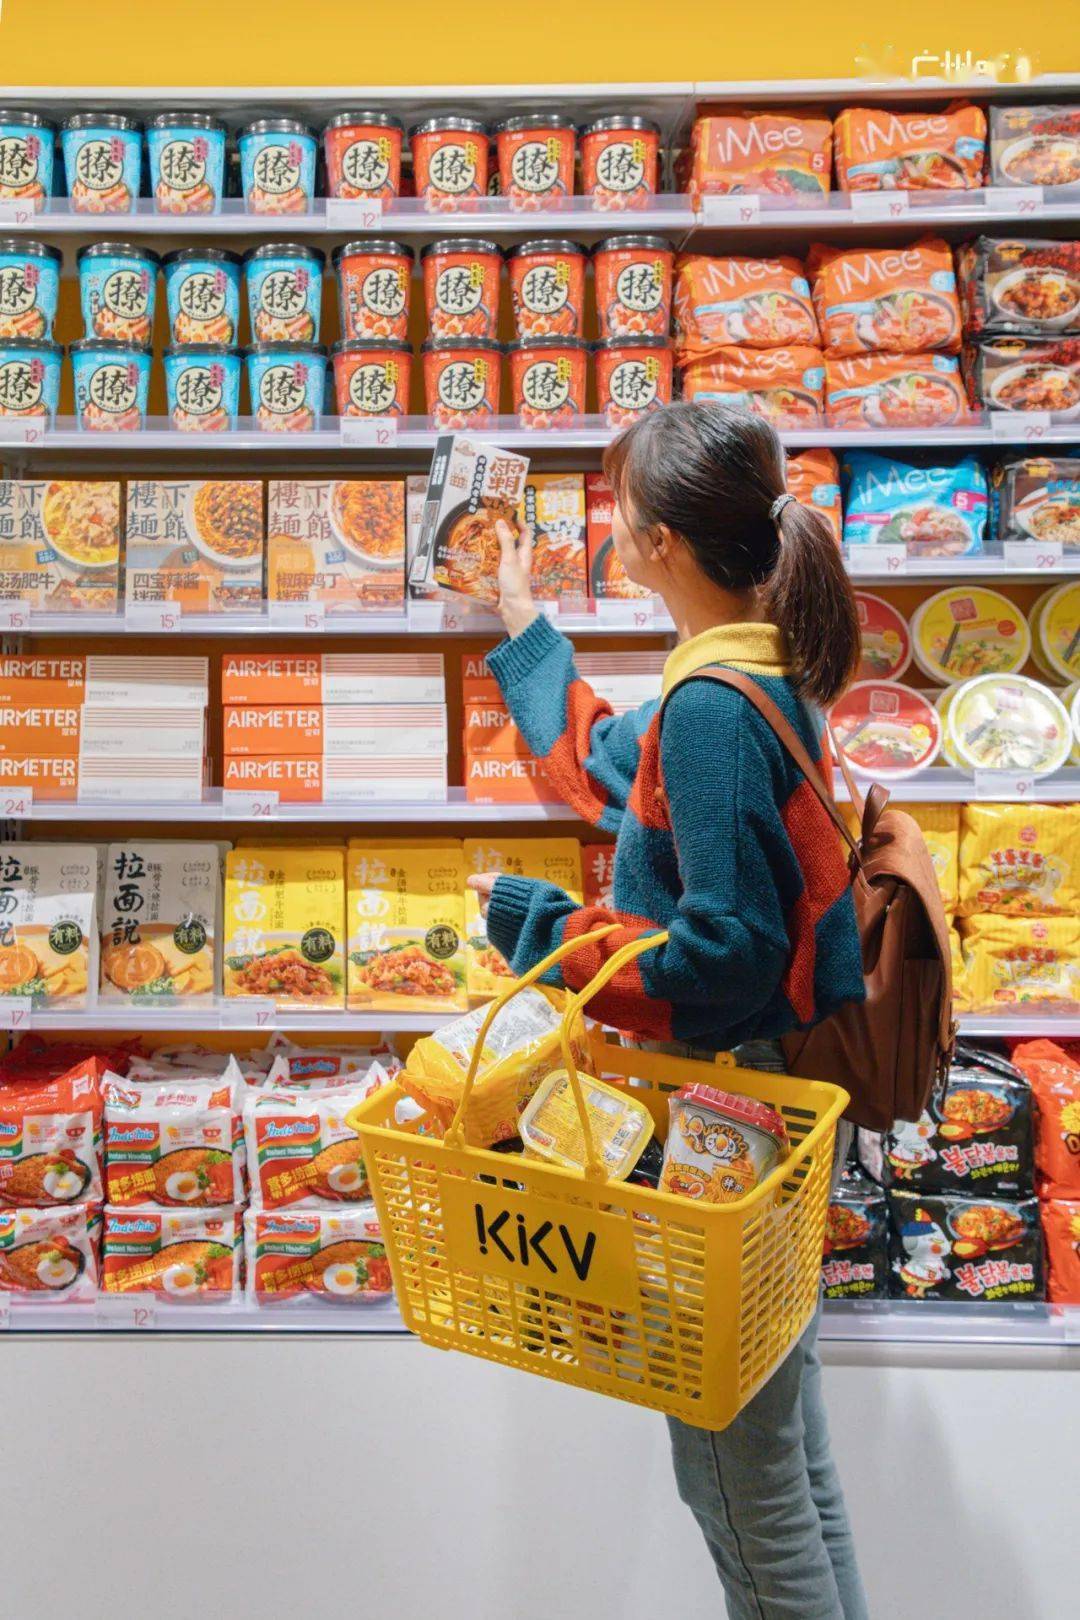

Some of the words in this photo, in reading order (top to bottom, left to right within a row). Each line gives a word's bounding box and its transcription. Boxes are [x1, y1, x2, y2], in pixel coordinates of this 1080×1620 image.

[717, 121, 803, 162] iMee
[859, 116, 947, 154] iMee
[702, 258, 784, 296] iMee
[834, 250, 924, 295] iMee
[858, 466, 953, 504] iMee
[225, 660, 319, 677] AIRMETER
[227, 710, 320, 728] AIRMETER
[226, 761, 320, 778] AIRMETER
